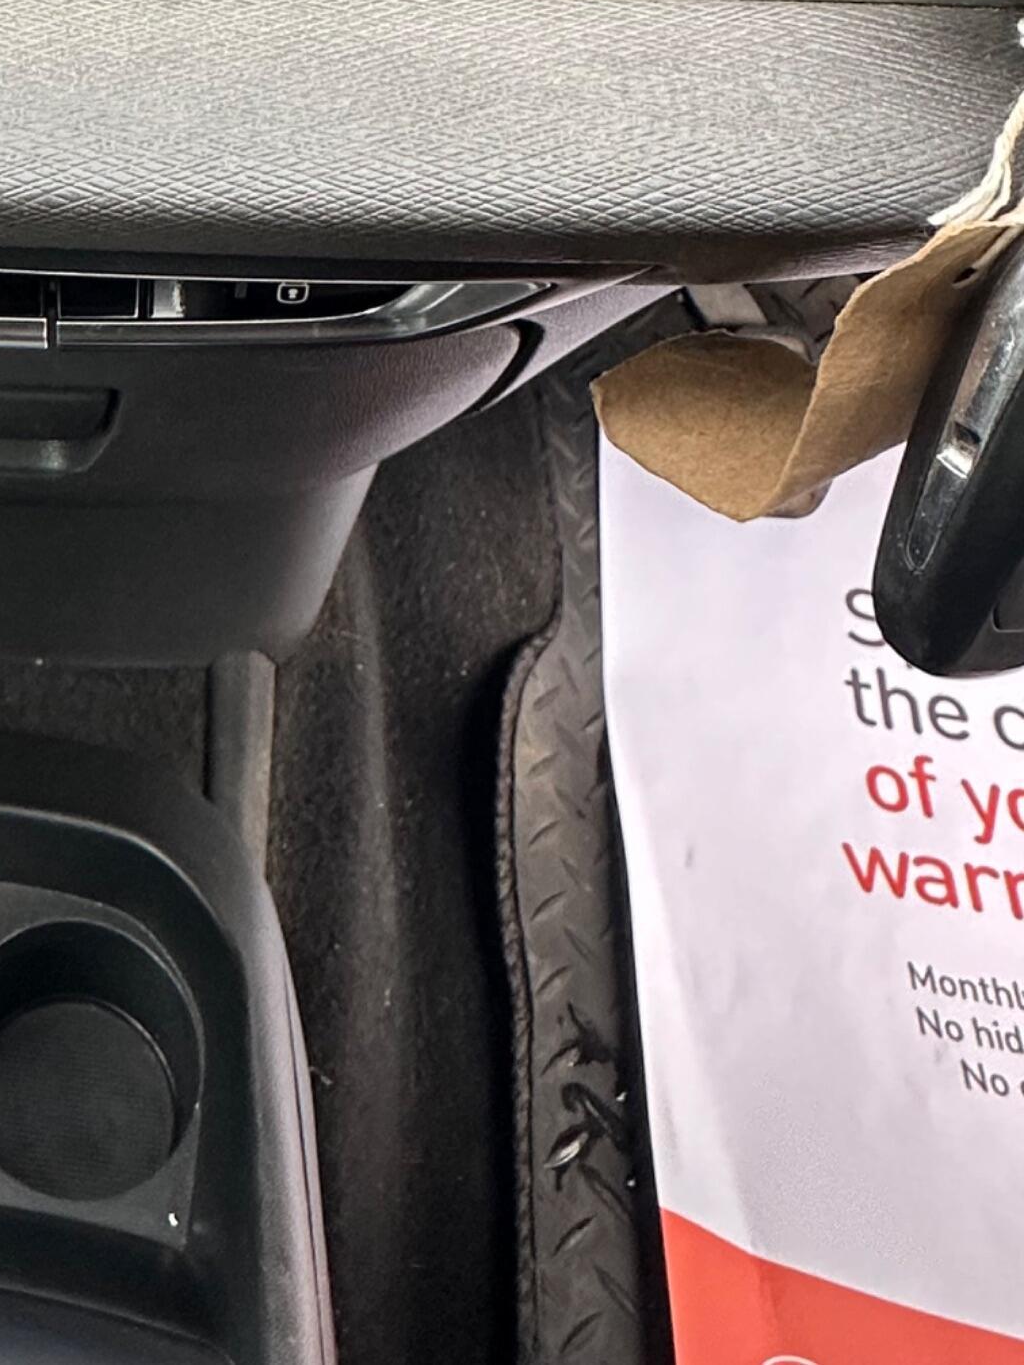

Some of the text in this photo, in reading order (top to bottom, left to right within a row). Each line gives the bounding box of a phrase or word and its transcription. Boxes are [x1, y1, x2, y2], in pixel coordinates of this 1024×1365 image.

[844, 666, 971, 741] the
[865, 755, 937, 819] of
[916, 1005, 964, 1043] No
[960, 1057, 1010, 1097] No
